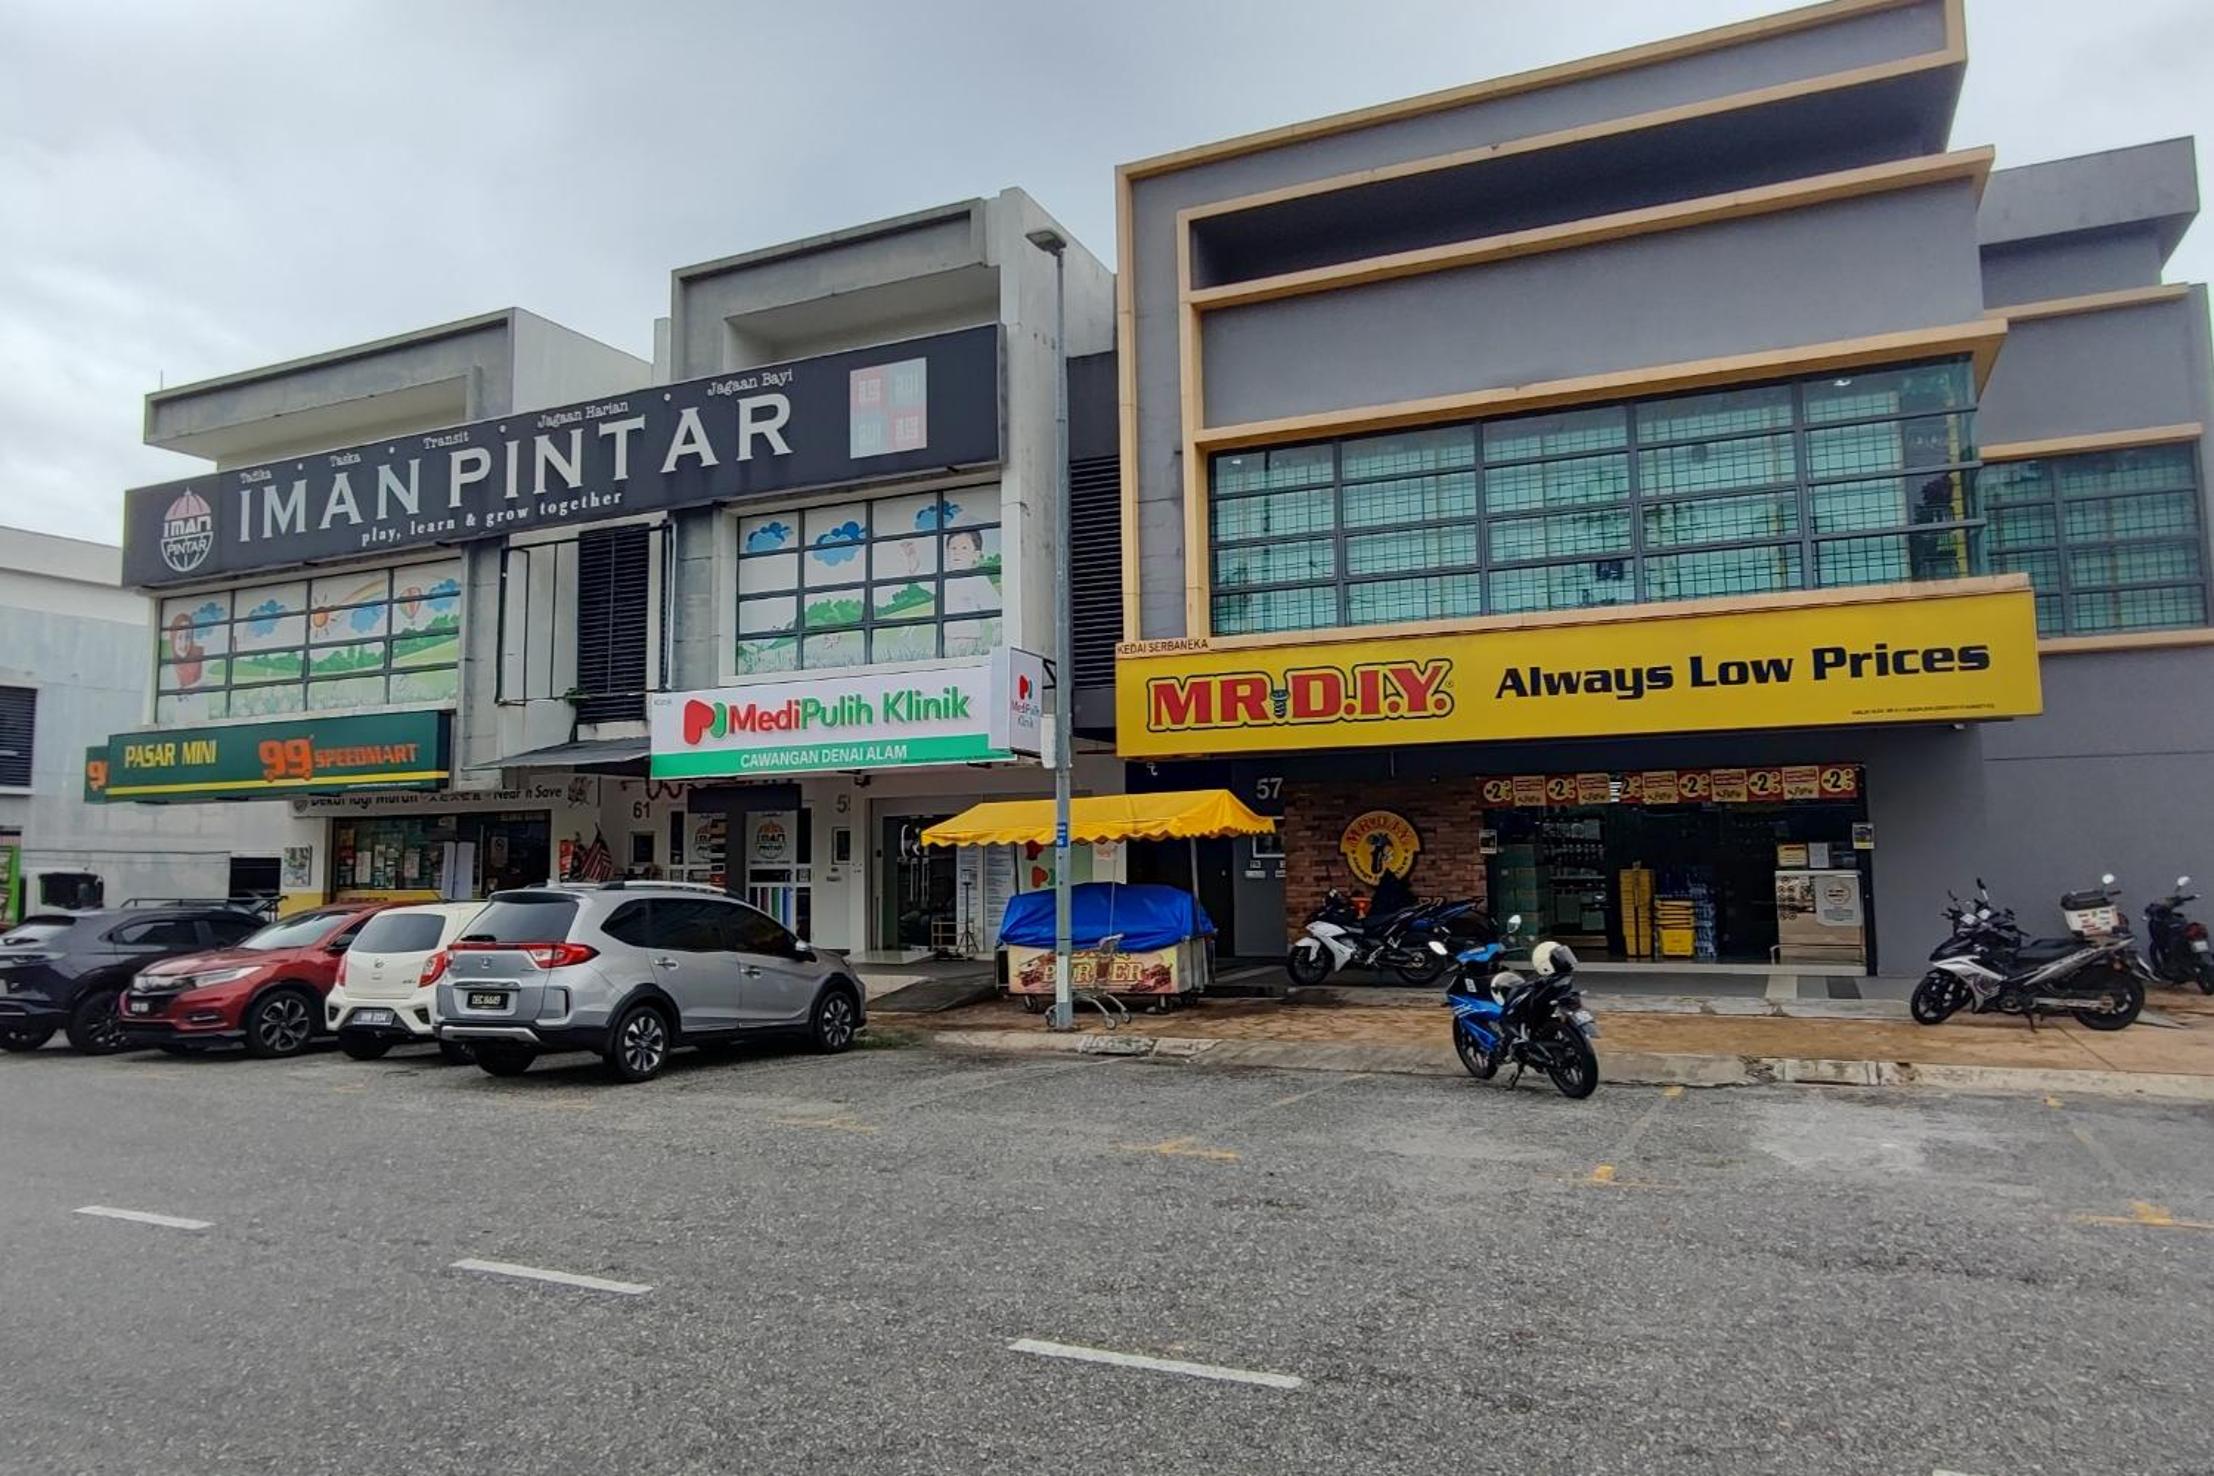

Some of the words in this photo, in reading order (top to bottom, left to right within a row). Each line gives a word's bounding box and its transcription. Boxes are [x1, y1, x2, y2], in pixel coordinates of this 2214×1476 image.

[707, 377, 758, 397] Jagaan
[761, 369, 793, 388] Bayi
[537, 408, 582, 429] Jagaan
[585, 400, 629, 420] Harian
[424, 432, 468, 450] Transit
[238, 458, 422, 542] IMAN
[447, 392, 794, 509] PINTAR
[330, 452, 361, 468] Taska
[410, 519, 455, 536] learn
[465, 513, 476, 527] &
[486, 507, 529, 528] grow
[539, 491, 622, 517] together
[163, 515, 212, 538] IMAN
[166, 540, 208, 557] PINTAR
[1117, 642, 1146, 655] KEDAI
[1148, 639, 1209, 653] SERBANEKA
[1496, 664, 1673, 700] Always
[1689, 655, 1794, 688] Low
[1812, 643, 1991, 681] Prices
[728, 693, 874, 734] MediPulih
[883, 686, 970, 723] Klinik
[124, 743, 175, 768] PASAR
[182, 740, 217, 764] MINI
[259, 738, 313, 783] 99
[315, 743, 418, 768] SPEEDMART
[740, 750, 819, 769] CAWANGAN
[822, 748, 863, 764] DENAI
[866, 744, 907, 761] ALAM
[535, 785, 561, 799] Save
[1256, 777, 1283, 800] 57
[632, 801, 650, 819] 61
